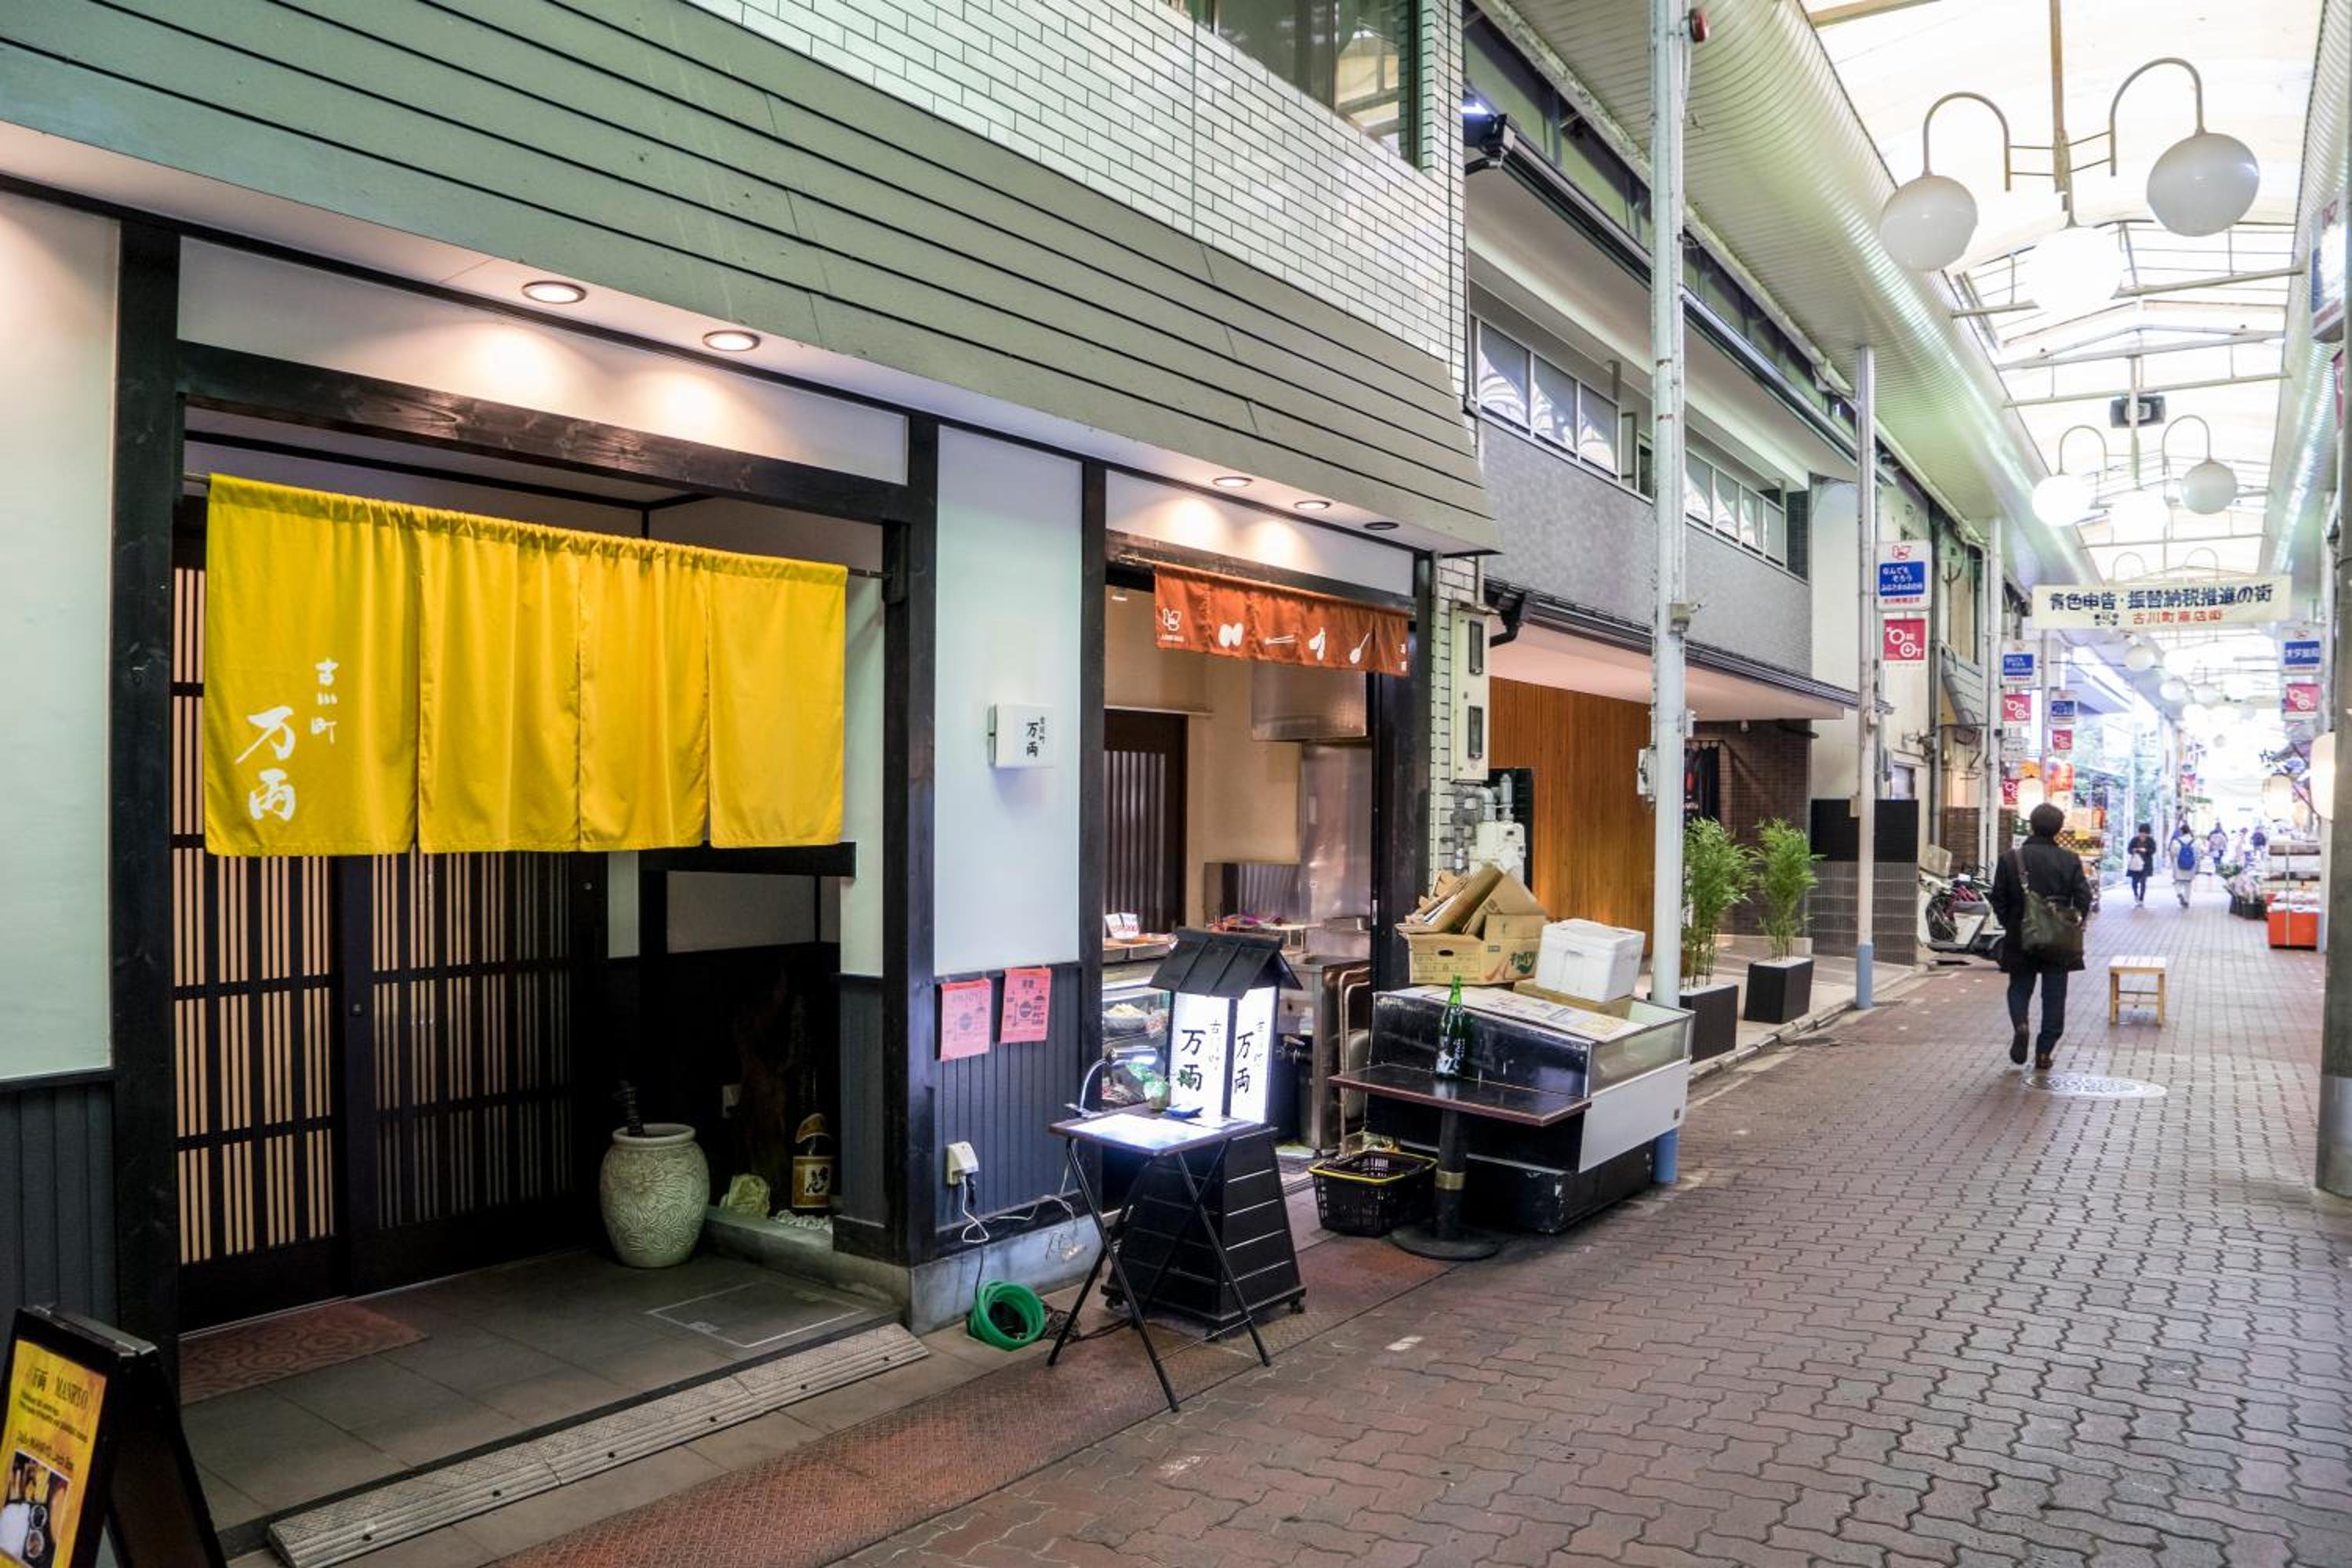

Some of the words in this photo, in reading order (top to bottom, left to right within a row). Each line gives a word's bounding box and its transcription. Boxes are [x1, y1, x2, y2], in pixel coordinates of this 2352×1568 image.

[310, 657, 339, 744] 古川町
[234, 705, 296, 822] 万両
[1026, 722, 1040, 758] 万両
[1235, 1031, 1255, 1094] 万両
